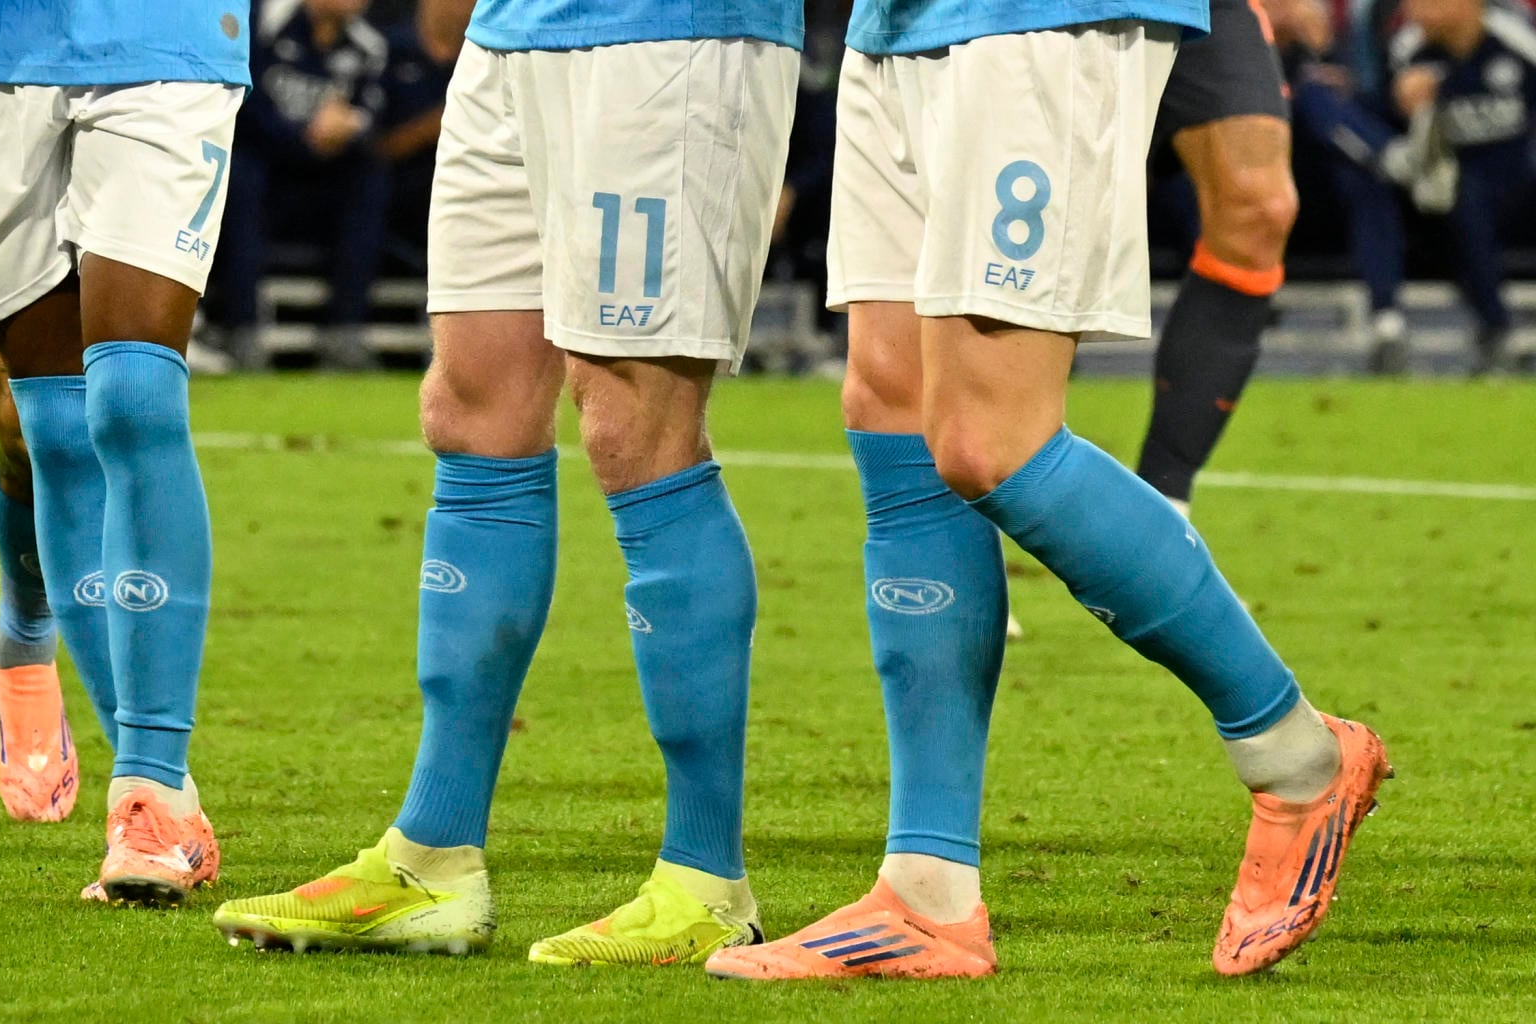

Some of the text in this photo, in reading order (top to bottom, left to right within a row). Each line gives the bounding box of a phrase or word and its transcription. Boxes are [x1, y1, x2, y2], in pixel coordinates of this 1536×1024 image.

[187, 139, 228, 234] 7
[991, 159, 1052, 262] 8
[175, 229, 211, 262] EA7
[592, 191, 667, 298] 11
[984, 262, 1036, 291] EA7
[600, 304, 654, 327] EA7
[124, 582, 150, 602] N
